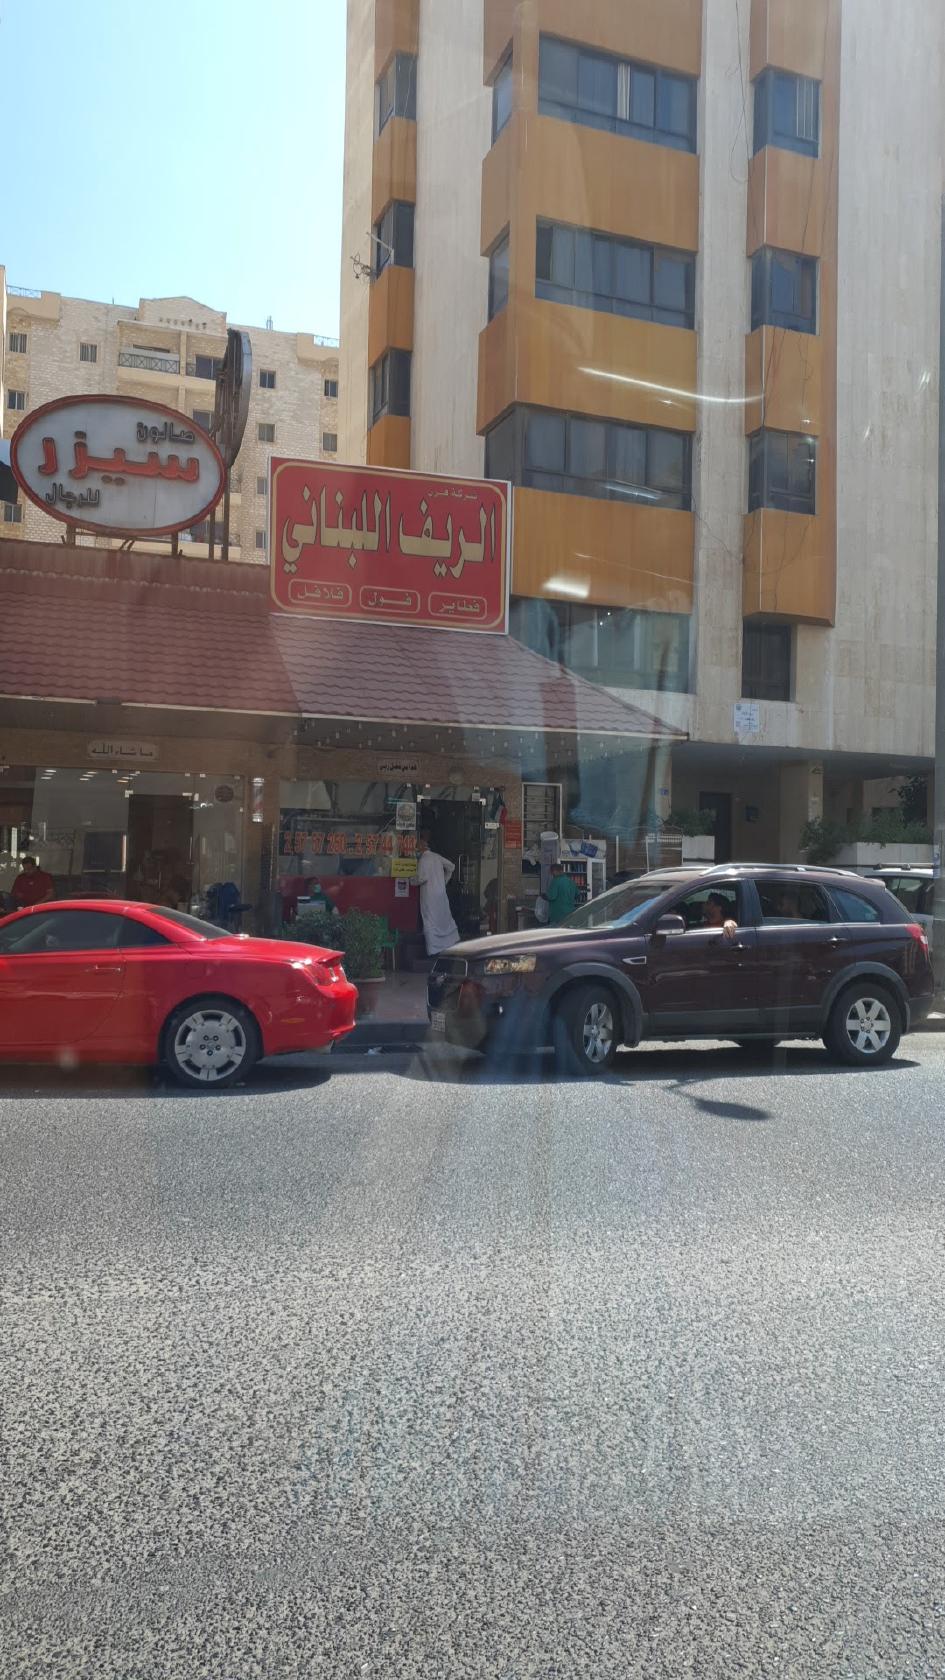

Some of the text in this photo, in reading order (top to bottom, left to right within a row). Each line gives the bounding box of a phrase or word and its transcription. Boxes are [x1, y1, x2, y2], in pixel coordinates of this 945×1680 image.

[136, 421, 195, 445] صالون
[38, 430, 200, 486] سيزر
[44, 482, 100, 509] للرجال
[281, 483, 496, 579] الريف اللبناني
[297, 583, 345, 601] فلافل
[368, 591, 412, 607] فول
